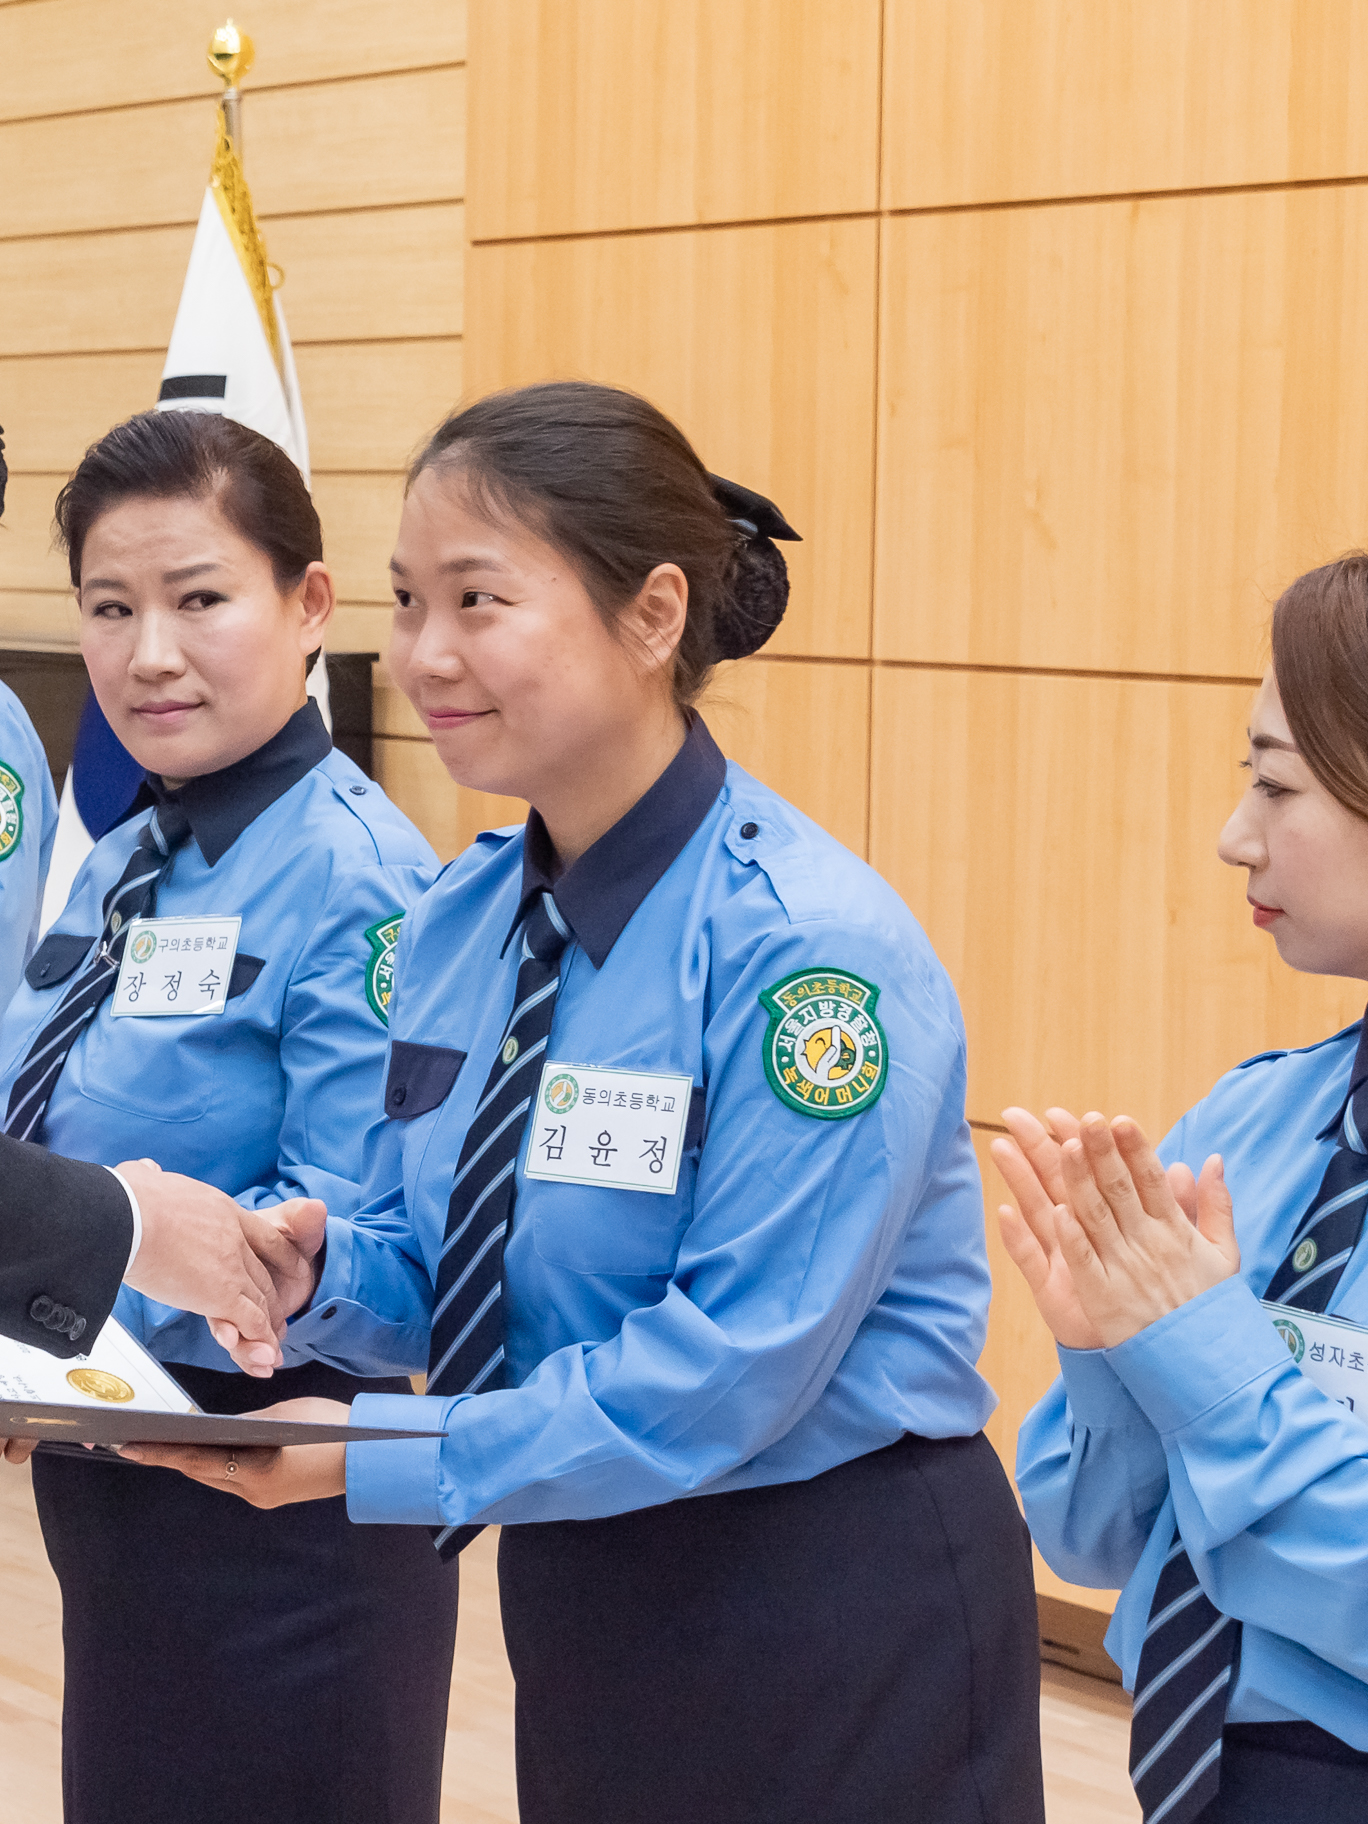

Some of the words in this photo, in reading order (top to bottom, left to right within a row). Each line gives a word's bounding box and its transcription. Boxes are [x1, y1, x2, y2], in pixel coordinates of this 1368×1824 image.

[158, 936, 228, 952] 구의초등학교
[782, 979, 863, 1007] 동의초등학교
[778, 1001, 877, 1052] 서울지방경찰청
[782, 1061, 879, 1105] 녹색어머니회
[582, 1087, 675, 1113] 동의초등학교
[1309, 1342, 1368, 1373] 성자초
